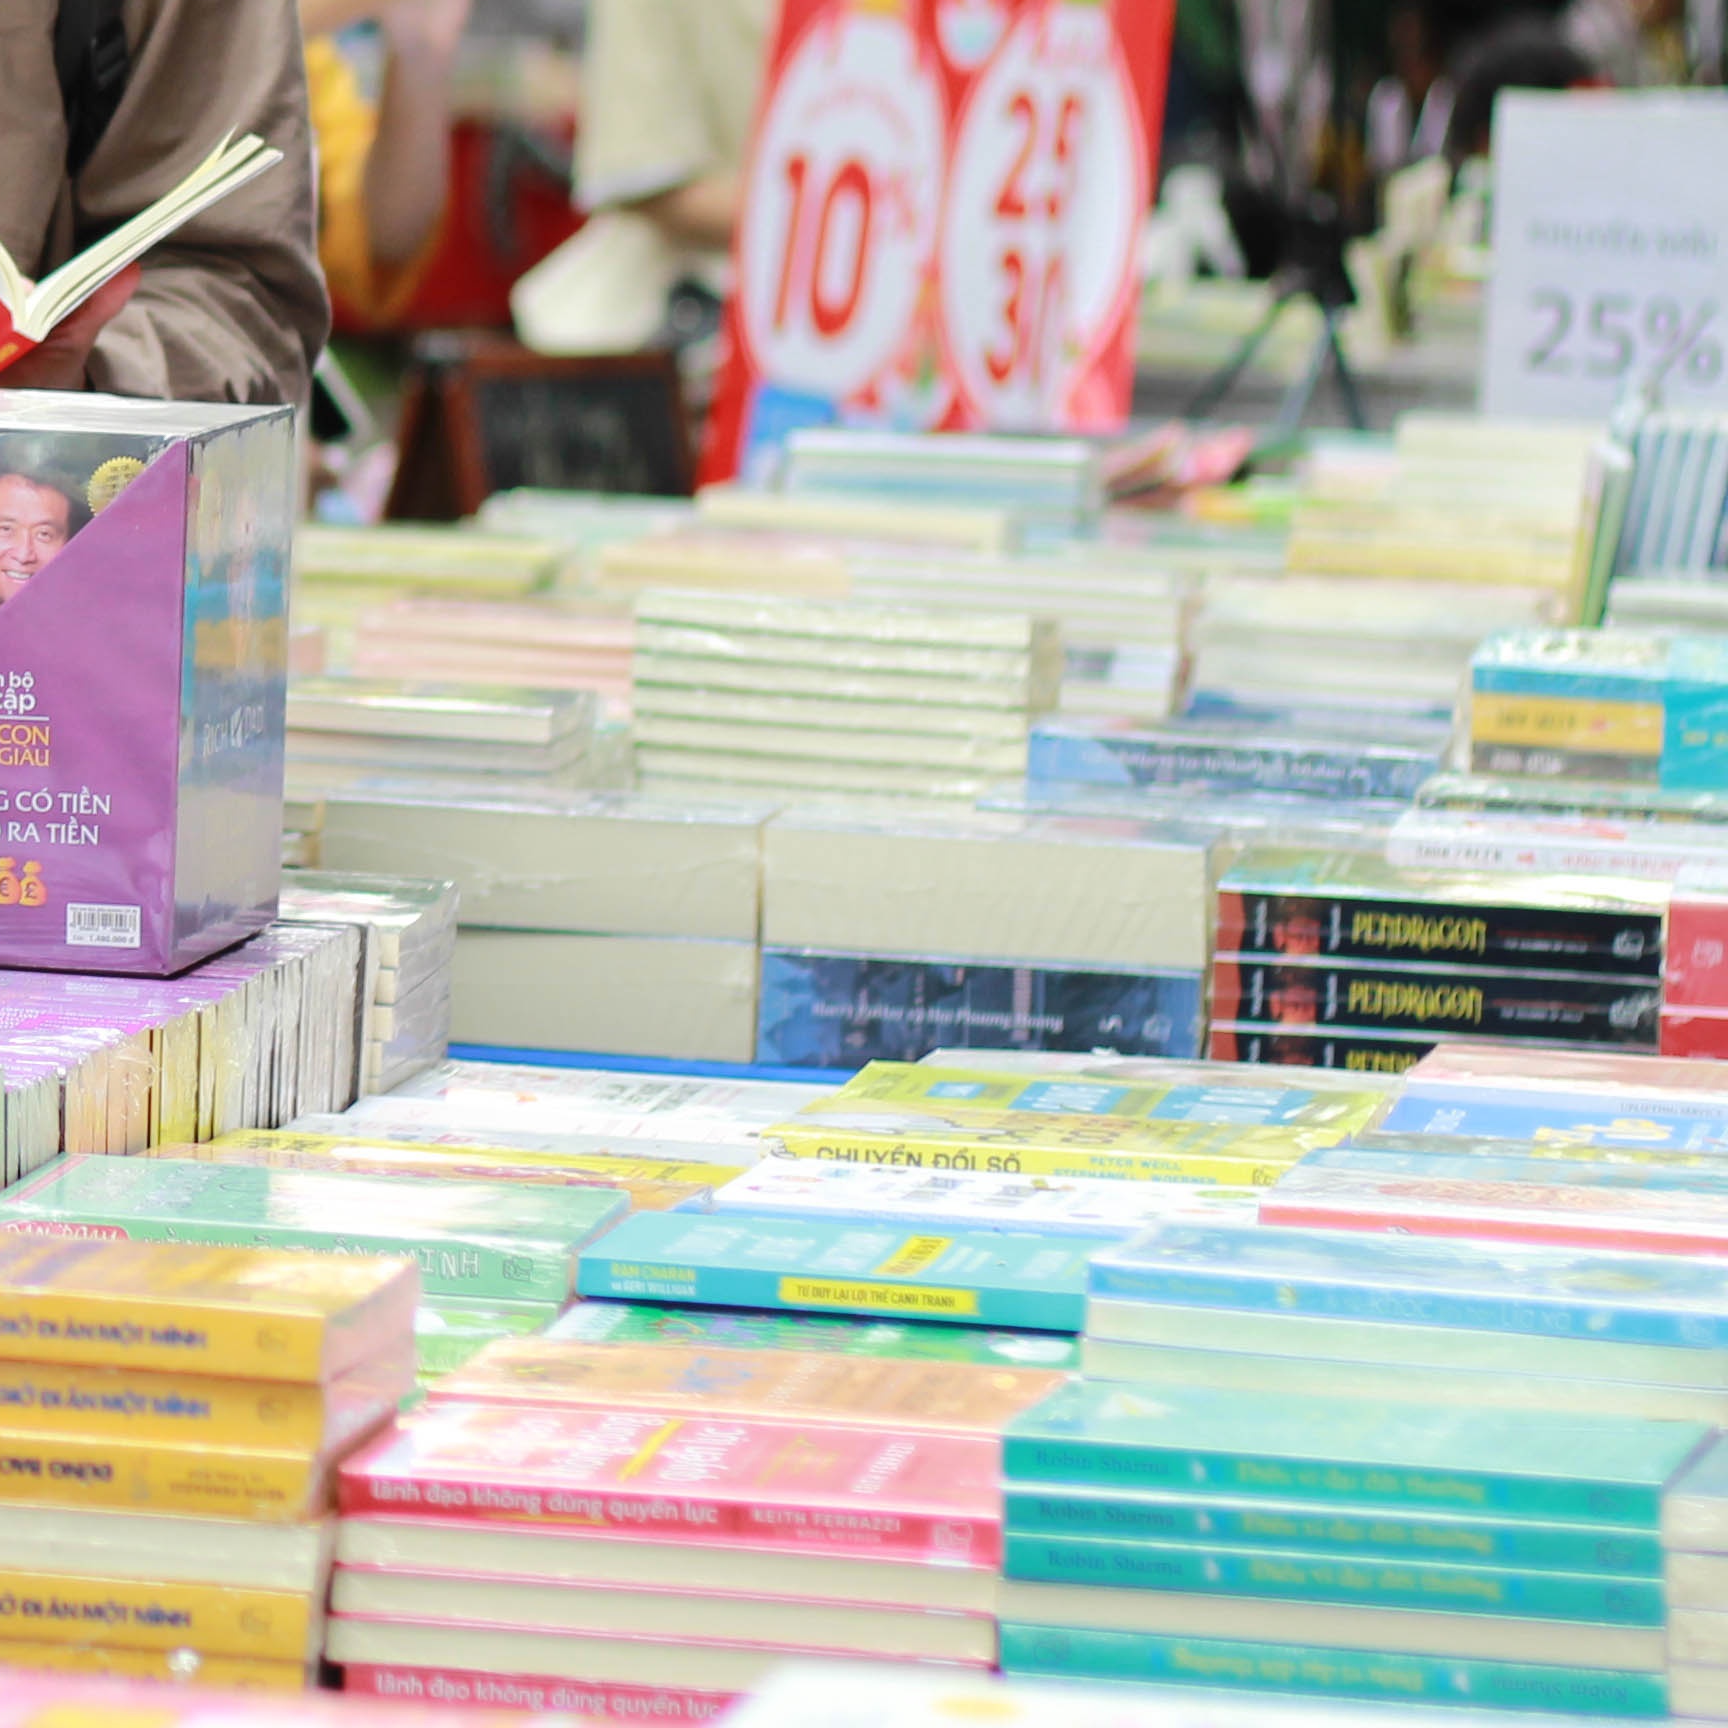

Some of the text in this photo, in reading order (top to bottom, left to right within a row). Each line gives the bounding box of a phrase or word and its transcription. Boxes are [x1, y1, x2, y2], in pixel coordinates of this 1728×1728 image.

[1525, 287, 1725, 387] 25%
[9, 671, 34, 691] bộ
[15, 787, 53, 814] CÓ
[57, 785, 111, 815] TIỀN
[7, 821, 41, 842] RA
[46, 815, 99, 845] TIỀN
[1351, 910, 1487, 956] PENDRAGON
[1347, 979, 1484, 1025] PENDRAGON
[812, 1286, 832, 1299] DUY
